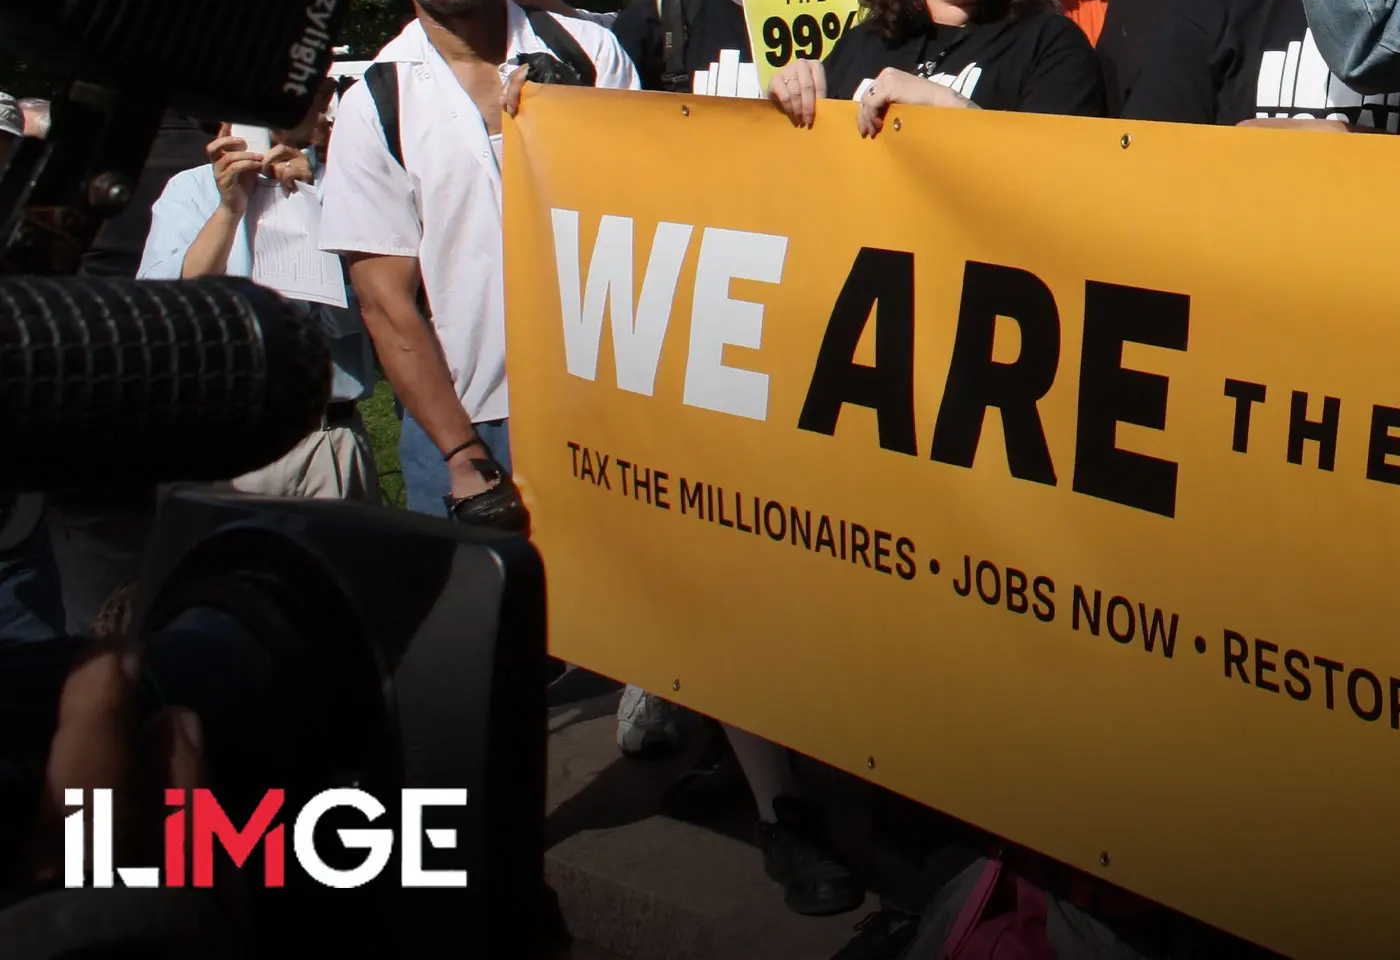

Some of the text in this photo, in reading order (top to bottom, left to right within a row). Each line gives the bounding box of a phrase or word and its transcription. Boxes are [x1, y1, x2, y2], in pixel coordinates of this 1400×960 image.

[550, 207, 789, 421] WE
[798, 246, 1191, 518] ARE
[567, 441, 613, 490] TAX
[616, 458, 671, 510] THE
[680, 477, 917, 581] MILLIONAIRES
[952, 553, 1056, 623] JOBS
[1071, 583, 1179, 659] NOW
